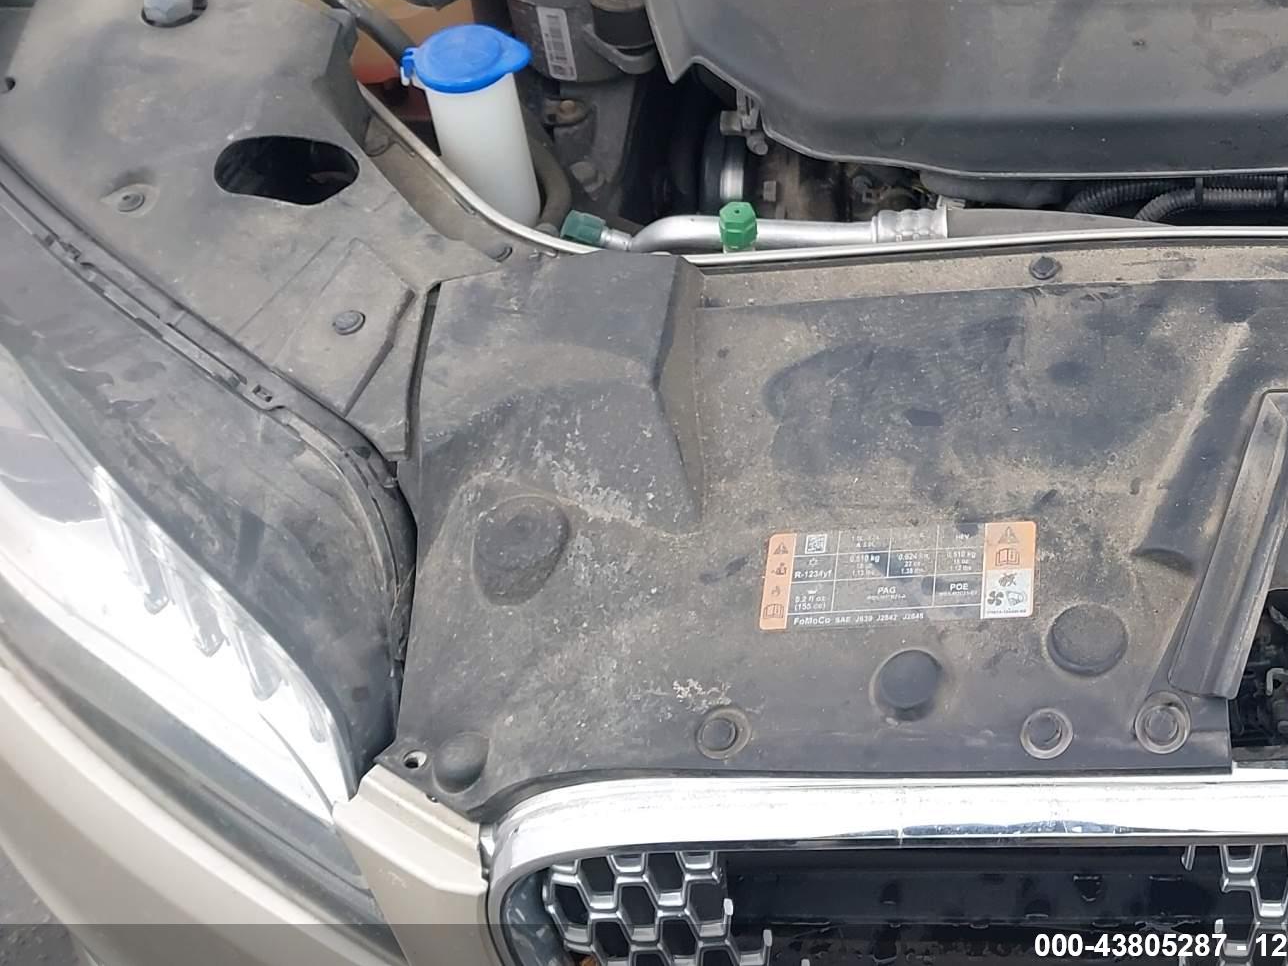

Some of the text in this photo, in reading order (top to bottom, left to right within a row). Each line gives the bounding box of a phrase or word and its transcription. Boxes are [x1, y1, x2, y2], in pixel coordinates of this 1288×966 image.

[877, 586, 897, 595] PAG
[949, 582, 969, 591] POE
[793, 616, 831, 626] FoMoCo
